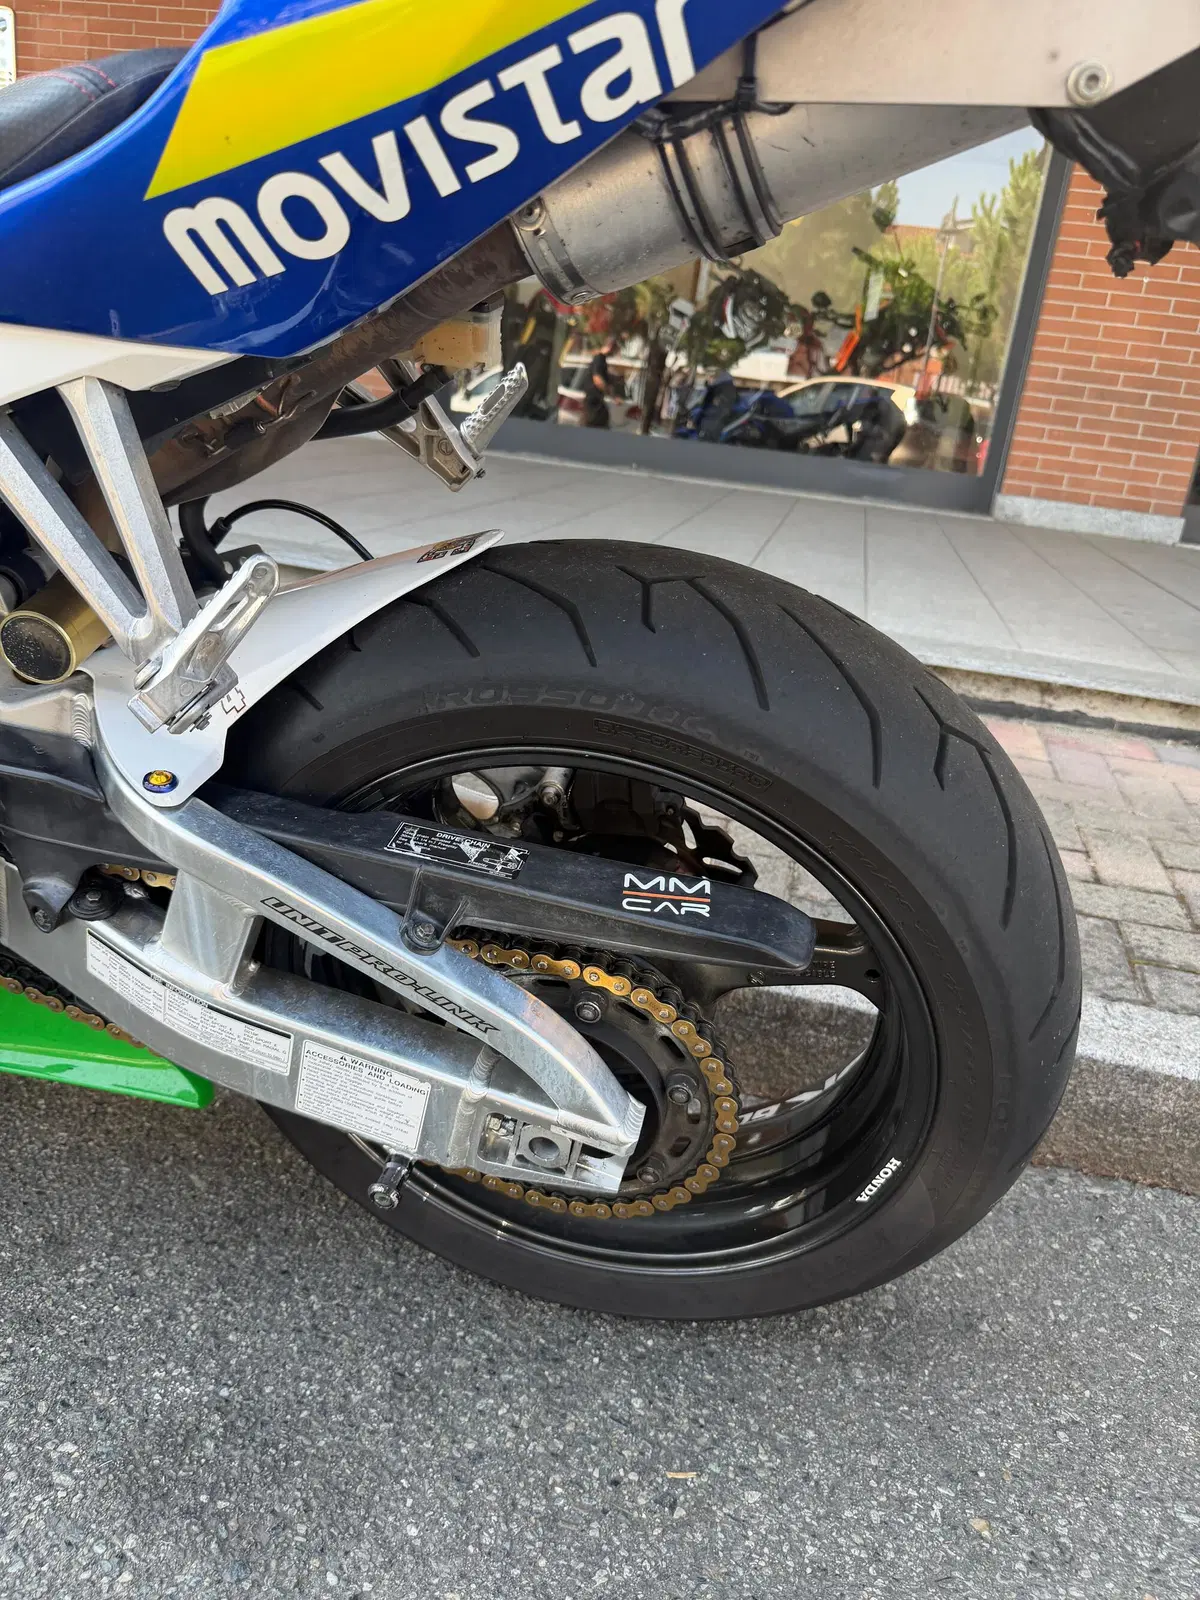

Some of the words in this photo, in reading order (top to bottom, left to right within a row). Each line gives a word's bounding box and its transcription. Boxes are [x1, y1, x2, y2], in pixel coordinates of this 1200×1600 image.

[435, 832, 461, 842] DRIVE
[464, 838, 490, 848] CHAIN
[623, 872, 711, 895] MM
[622, 897, 710, 918] CAR
[260, 896, 346, 943] UNIT
[337, 940, 500, 1034] PRO-LINK
[305, 1049, 364, 1074] ACCESSORIES
[367, 1071, 386, 1081] AND
[389, 1078, 426, 1096] LOADING
[350, 1058, 394, 1078] WARNING
[855, 1157, 902, 1203] HONDA
